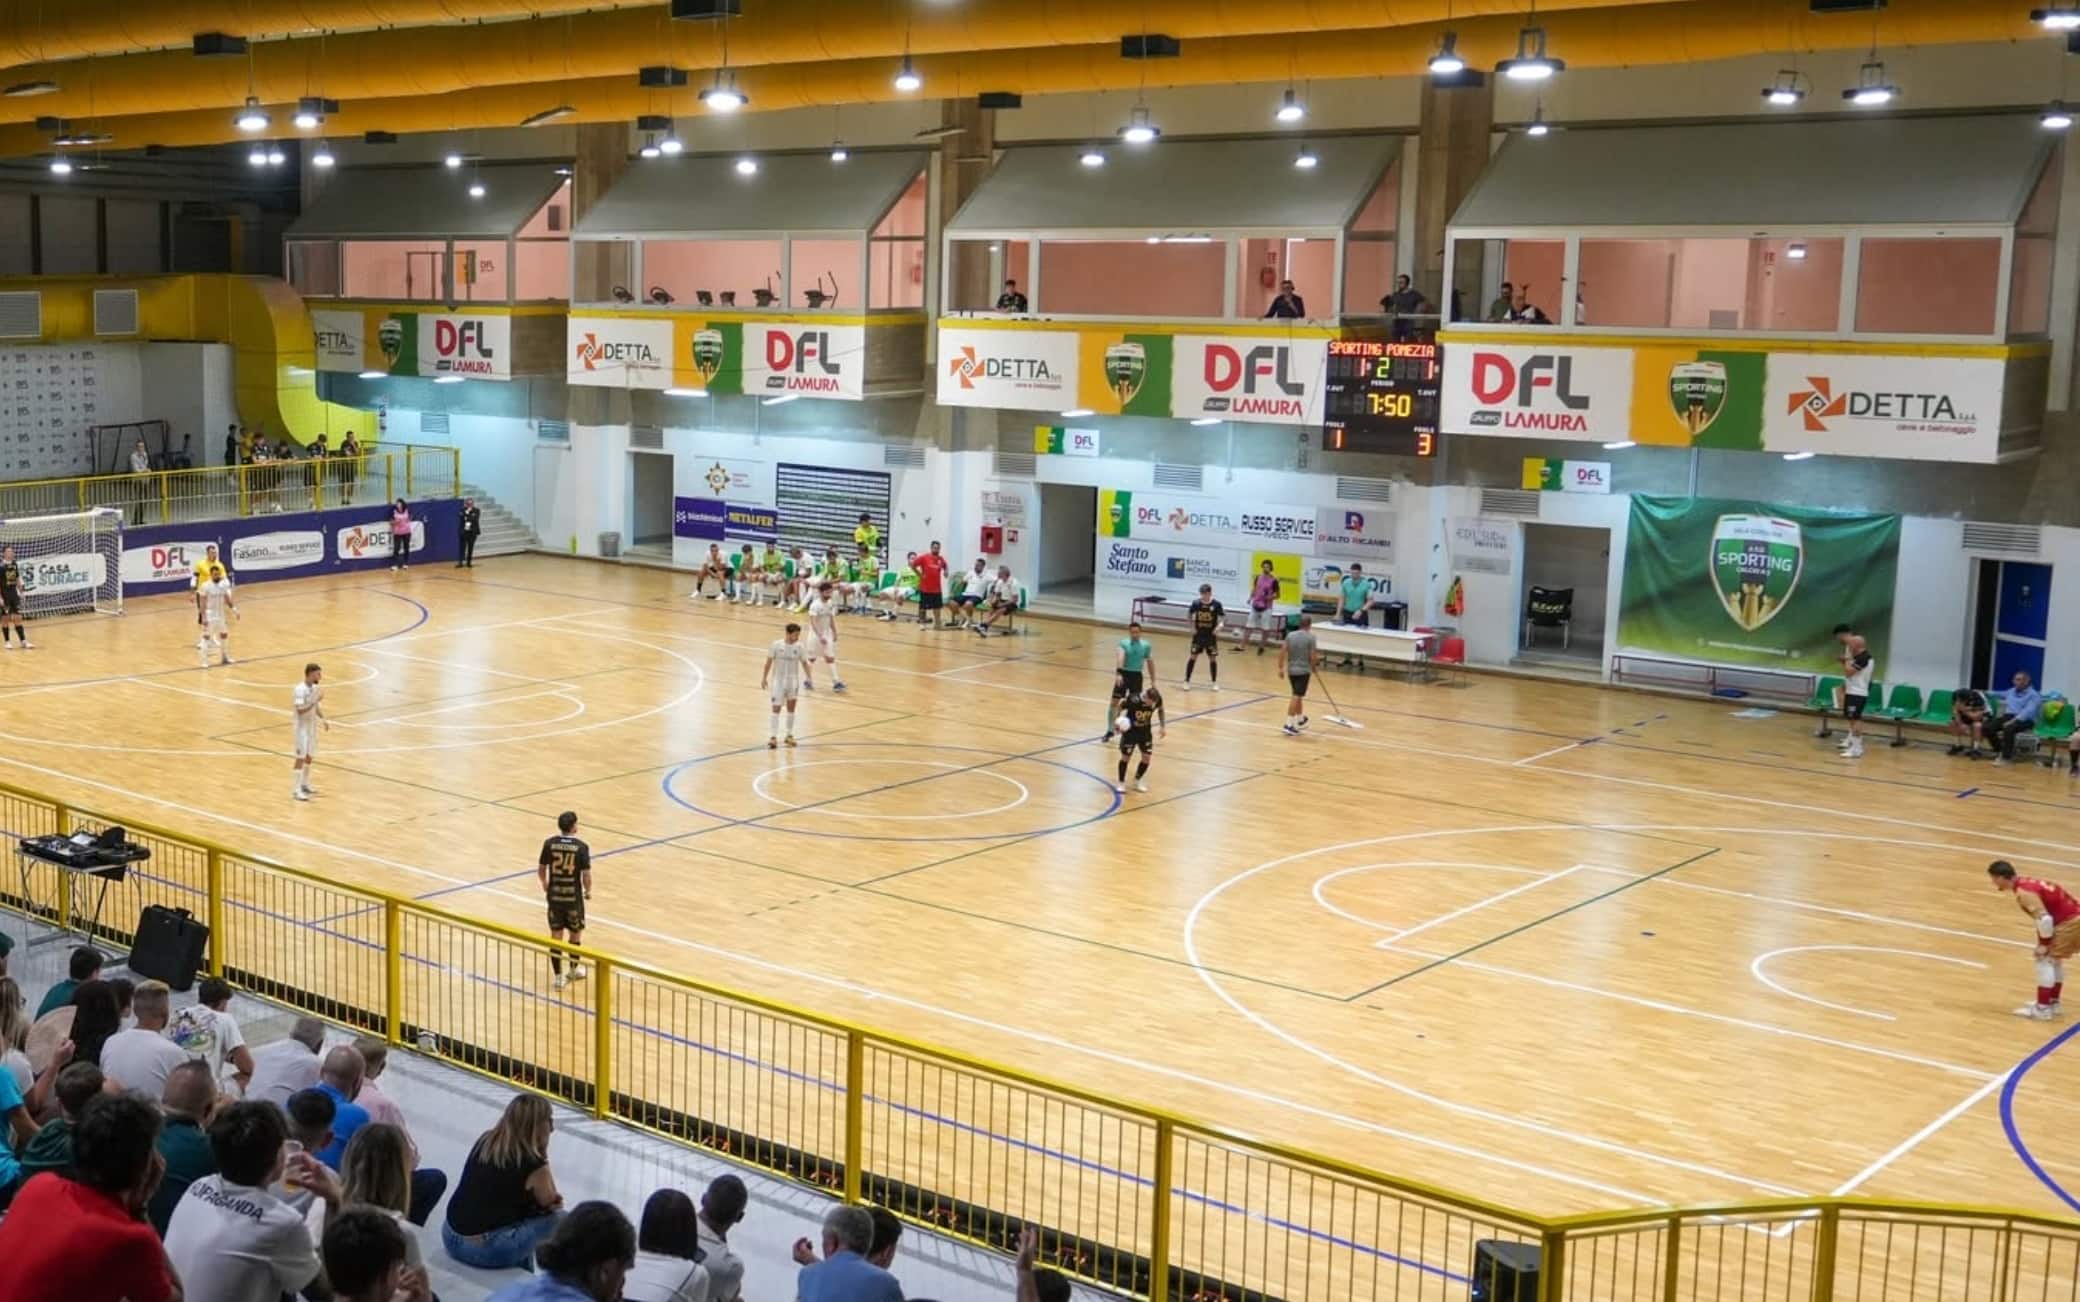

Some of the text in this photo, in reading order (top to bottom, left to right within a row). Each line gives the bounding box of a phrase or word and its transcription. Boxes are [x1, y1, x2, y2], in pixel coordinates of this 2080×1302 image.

[435, 319, 493, 358] DFL
[604, 343, 652, 360] DETTA
[766, 330, 840, 375] DFL
[1329, 342, 1434, 357] SPORTING POMEZIA
[452, 359, 492, 374] LAMURA
[986, 358, 1049, 379] DETTA
[1204, 344, 1304, 396] DFL
[1360, 357, 1433, 380] 1 2 1
[787, 377, 839, 392] LAMURA
[1471, 352, 1590, 410] DFL
[1672, 383, 1723, 394] SPORTING
[1233, 398, 1302, 417] LAMURA
[1367, 393, 1411, 417] 7:50
[1849, 391, 1956, 419] DETTA
[1505, 412, 1588, 432] LAMURA
[1074, 435, 1094, 446] DFL
[1336, 429, 1431, 455] 1 3
[1577, 468, 1603, 482] DFL
[729, 511, 774, 527] METALFER
[1138, 507, 1162, 521] DFL
[1190, 513, 1230, 528] DETTA
[1241, 514, 1314, 536] RUSSO SERVICE
[151, 547, 190, 569] DFL
[233, 547, 269, 560] Fasano
[1111, 543, 1149, 559] Santo
[39, 562, 70, 575] CASA
[1106, 556, 1157, 575] Stefano
[1717, 551, 1793, 572] SPORTING
[41, 572, 88, 586] SURACE
[551, 852, 576, 876] 24
